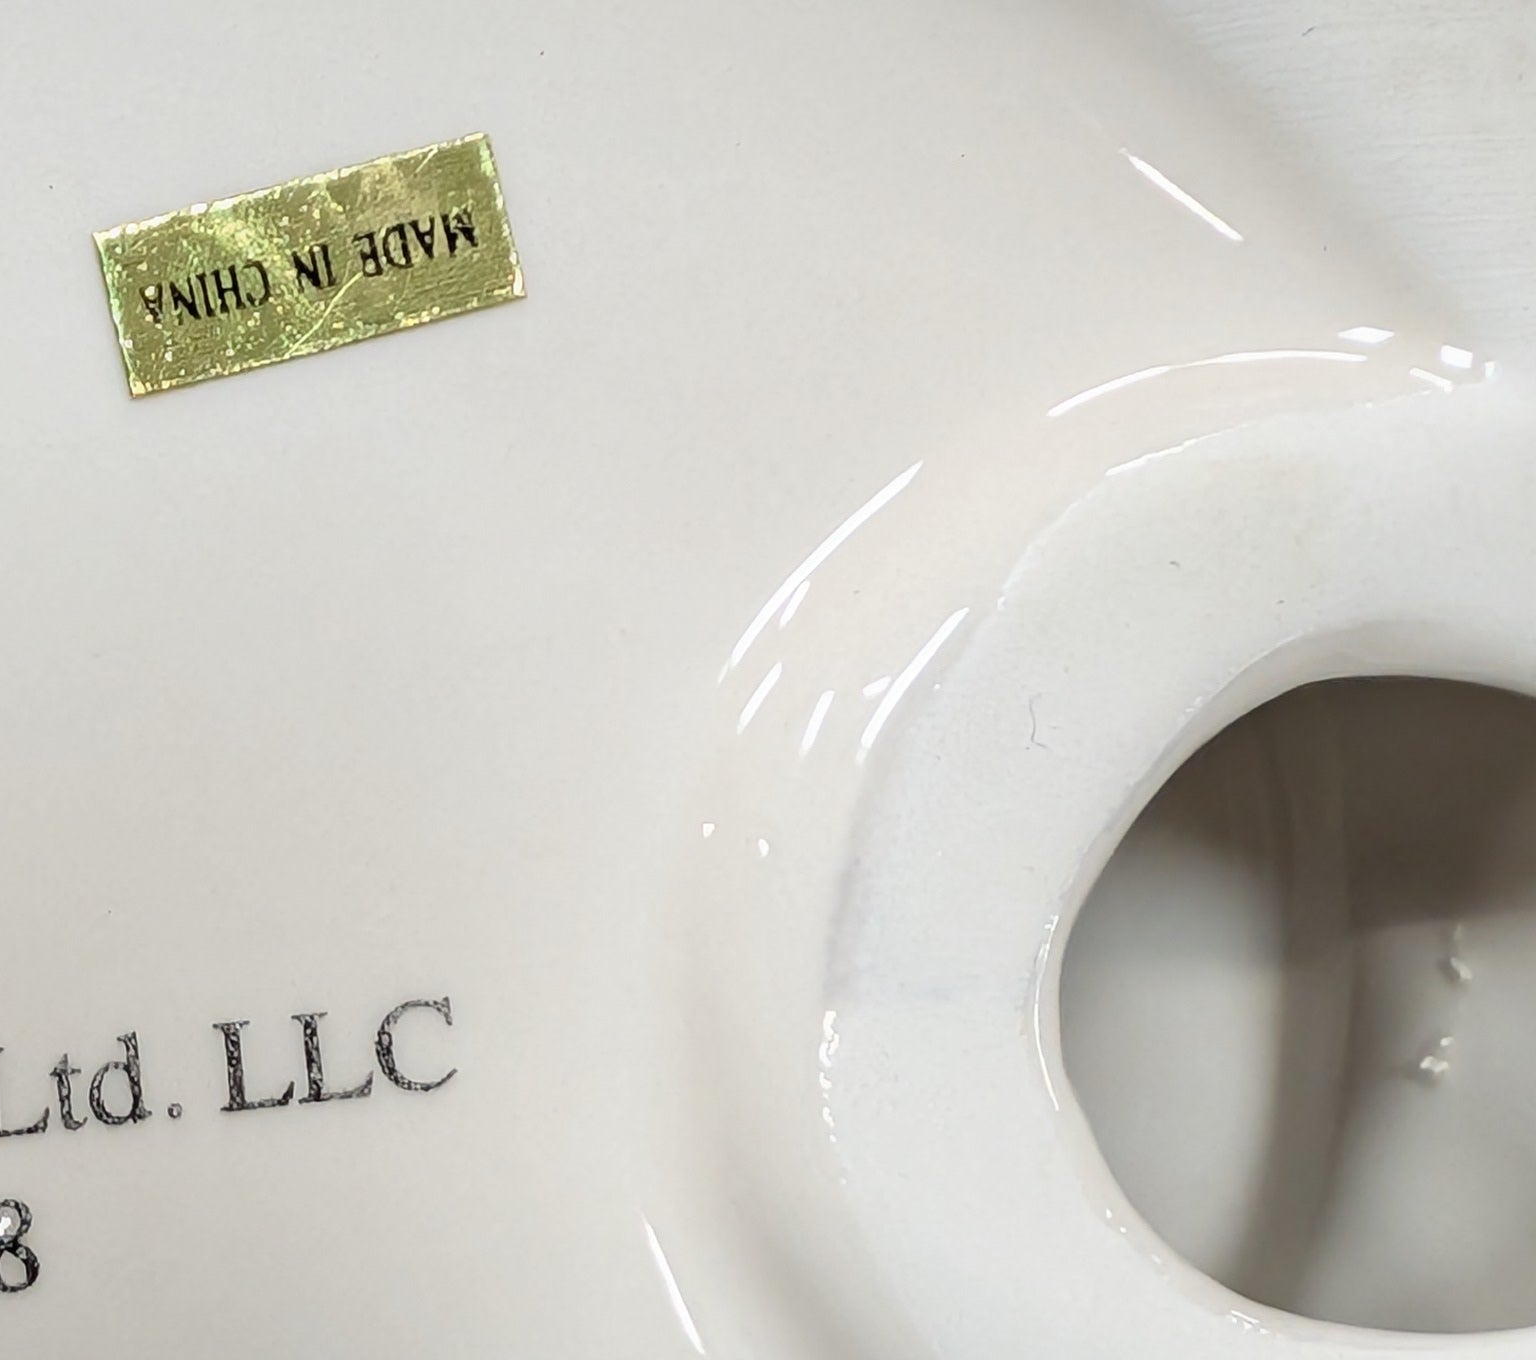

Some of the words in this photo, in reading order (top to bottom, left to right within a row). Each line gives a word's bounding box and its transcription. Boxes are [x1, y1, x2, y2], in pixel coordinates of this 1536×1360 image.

[291, 243, 338, 294] IN
[353, 208, 480, 279] MADE
[139, 263, 271, 326] CHINA
[211, 995, 459, 1113] LLC
